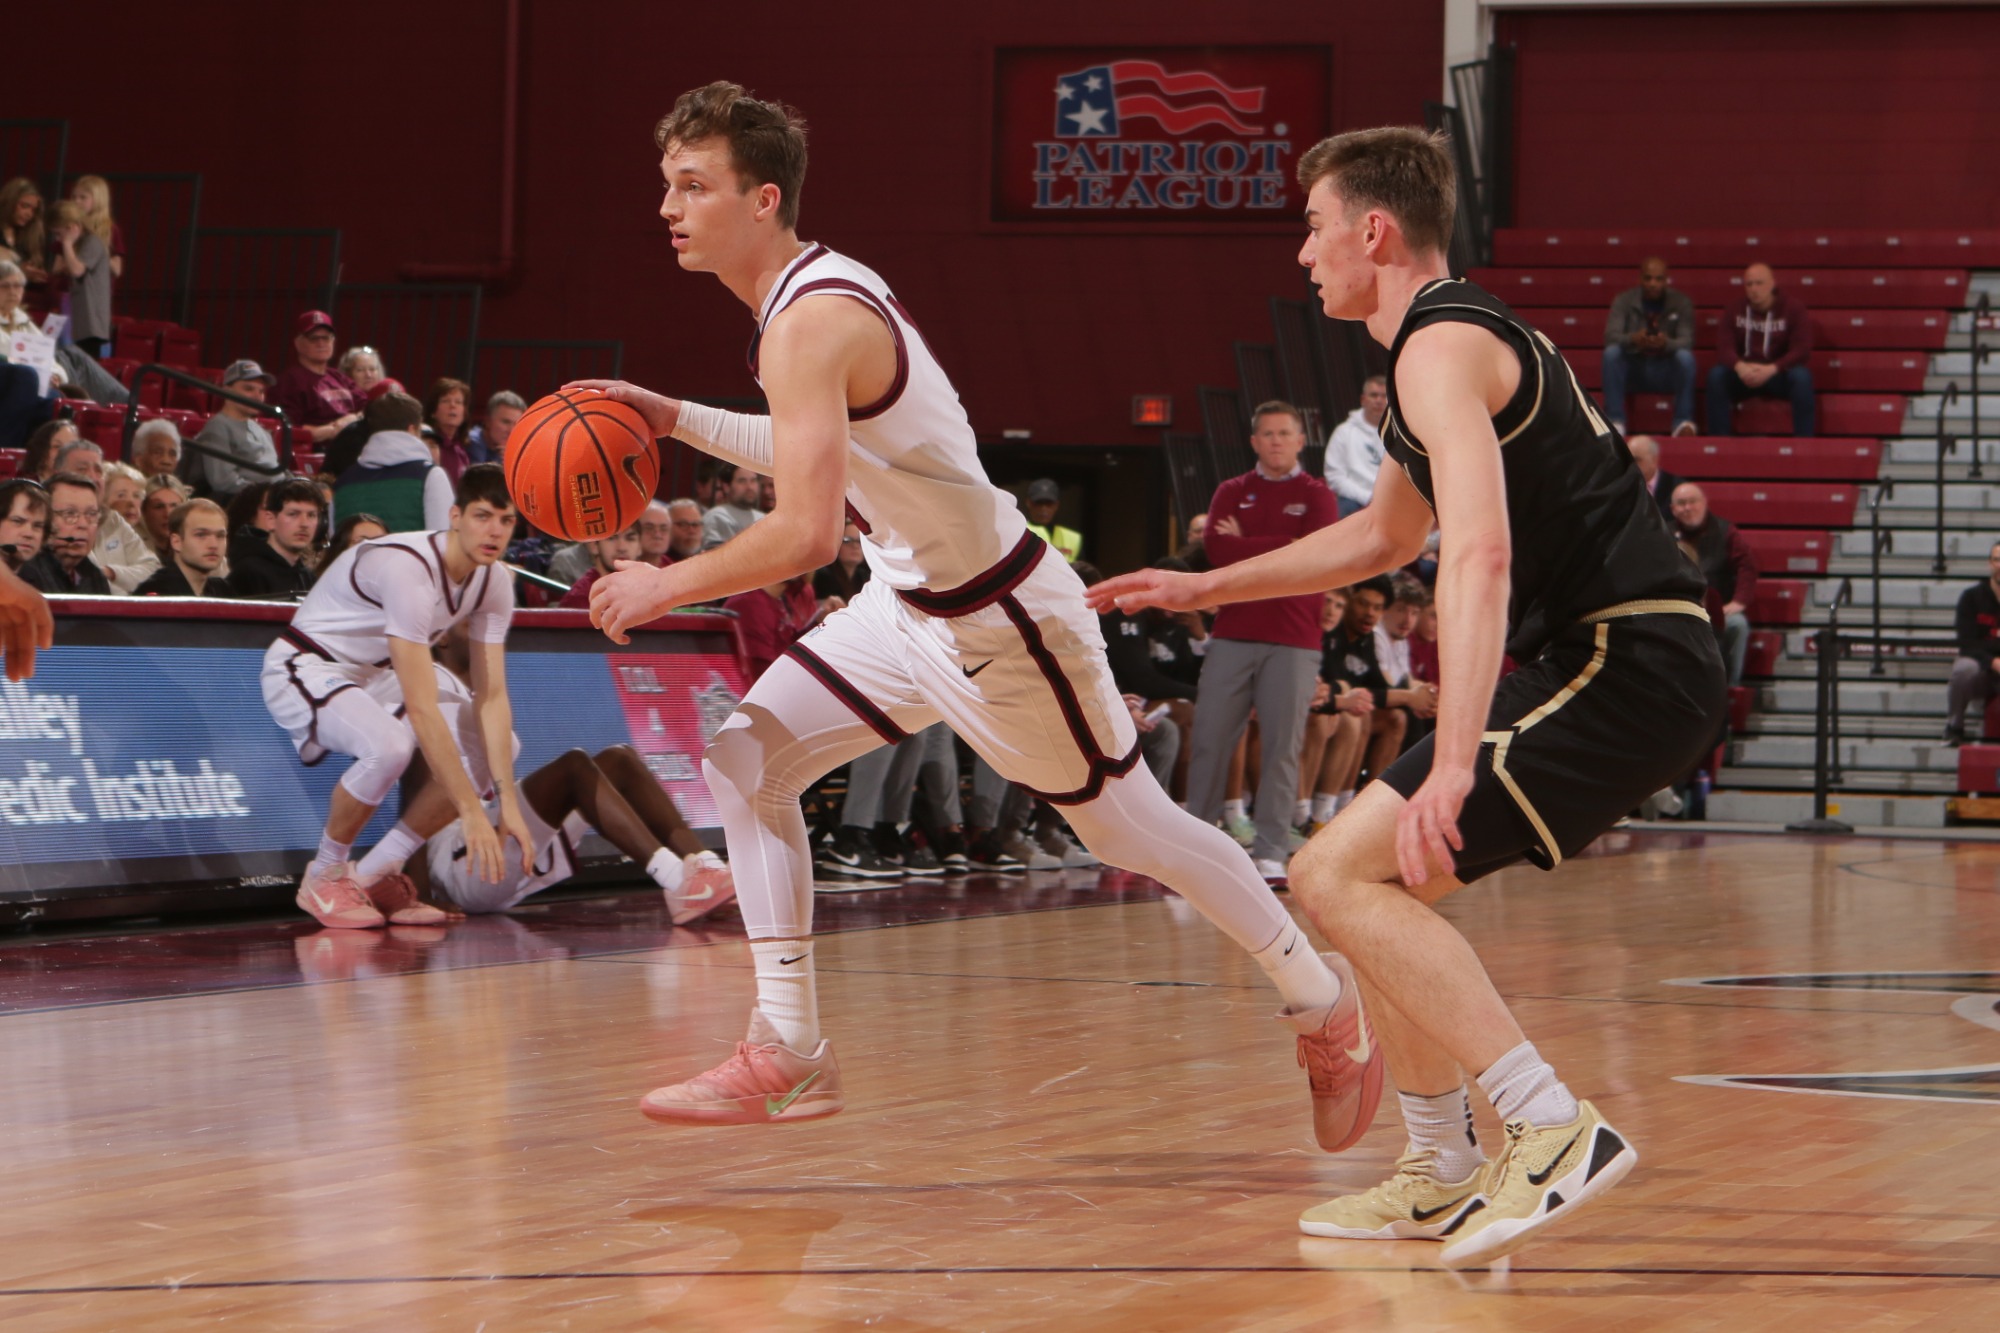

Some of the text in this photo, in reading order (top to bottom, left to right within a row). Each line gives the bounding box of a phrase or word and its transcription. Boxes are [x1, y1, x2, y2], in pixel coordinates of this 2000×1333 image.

[1032, 141, 1291, 176] PATRIOT
[1032, 176, 1286, 208] LEAGUE
[577, 472, 606, 536] ELITE
[81, 758, 250, 822] Institute
